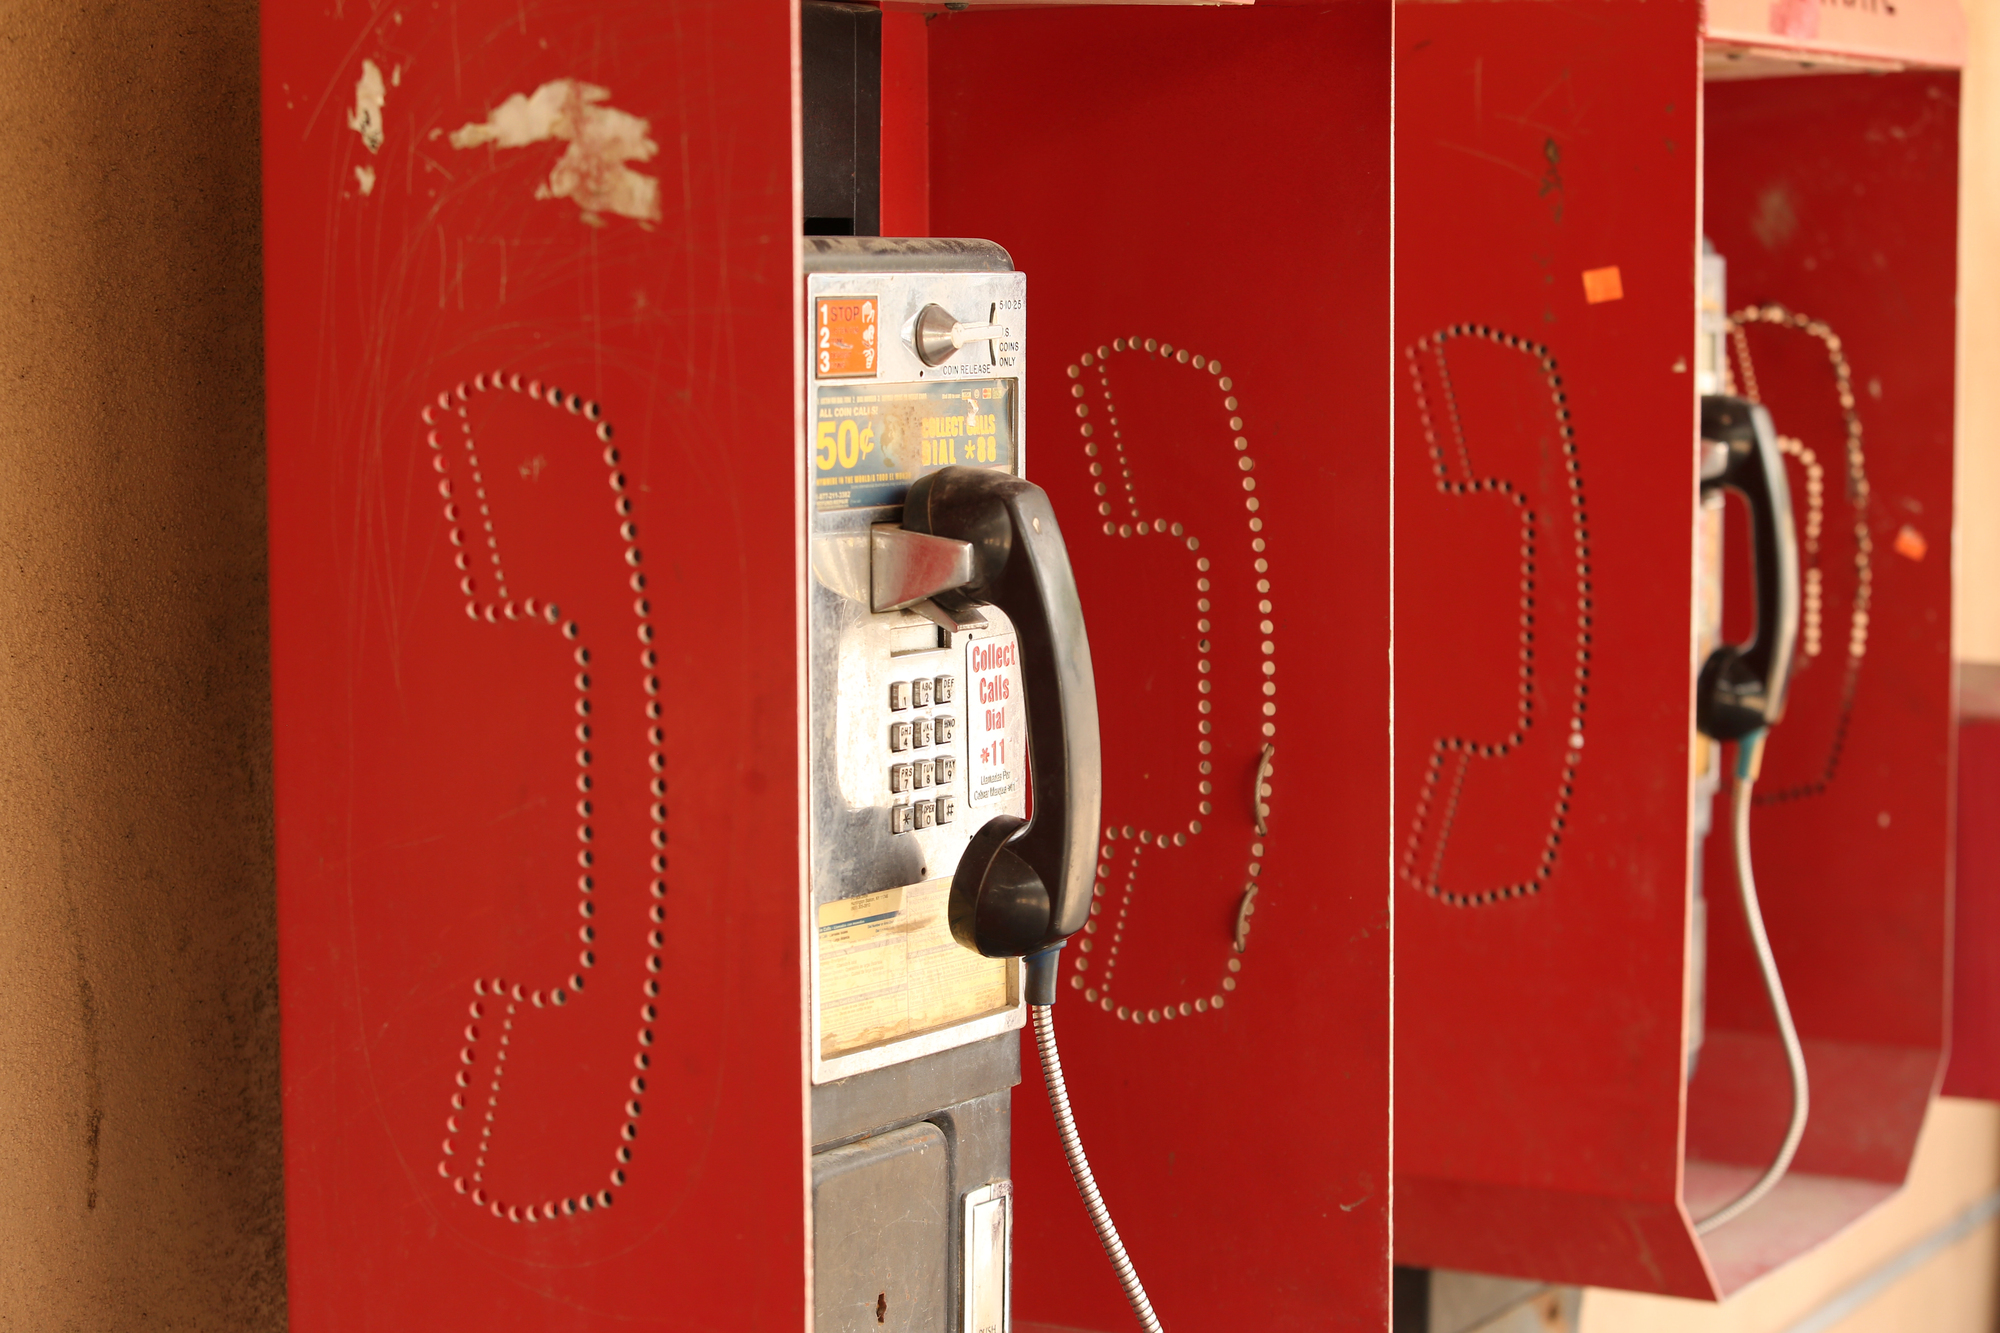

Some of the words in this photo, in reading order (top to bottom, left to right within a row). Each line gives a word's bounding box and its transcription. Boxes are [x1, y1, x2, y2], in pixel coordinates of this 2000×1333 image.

[820, 304, 828, 325] 1
[830, 306, 860, 322] STOP
[820, 326, 830, 349] 2
[999, 342, 1019, 352] COINS
[820, 350, 830, 373] 3
[999, 357, 1016, 367] ONLY
[942, 365, 959, 375] COIN
[961, 364, 991, 375] RELEASE
[819, 408, 833, 418] ALL
[834, 407, 852, 417] COIN
[921, 415, 965, 439] COLLECT
[816, 419, 875, 471] 50¢
[921, 438, 957, 466] DIAL
[972, 640, 1016, 673] Collect
[921, 682, 933, 691] ABC
[943, 678, 955, 688] DEF
[946, 689, 951, 699] 3
[979, 674, 1010, 705] Calls
[924, 693, 929, 702] 2
[985, 706, 1005, 732] Dial
[900, 727, 912, 737] GHI
[922, 722, 933, 732] JKL
[925, 733, 930, 743] 5
[946, 730, 952, 740] 6
[903, 738, 908, 746] 4
[901, 767, 913, 778] PRS
[923, 763, 935, 773] TUV
[926, 774, 931, 784] 8
[947, 770, 952, 780] 9
[904, 779, 909, 789] 7
[923, 804, 935, 815] OPER
[926, 815, 931, 825] 0
